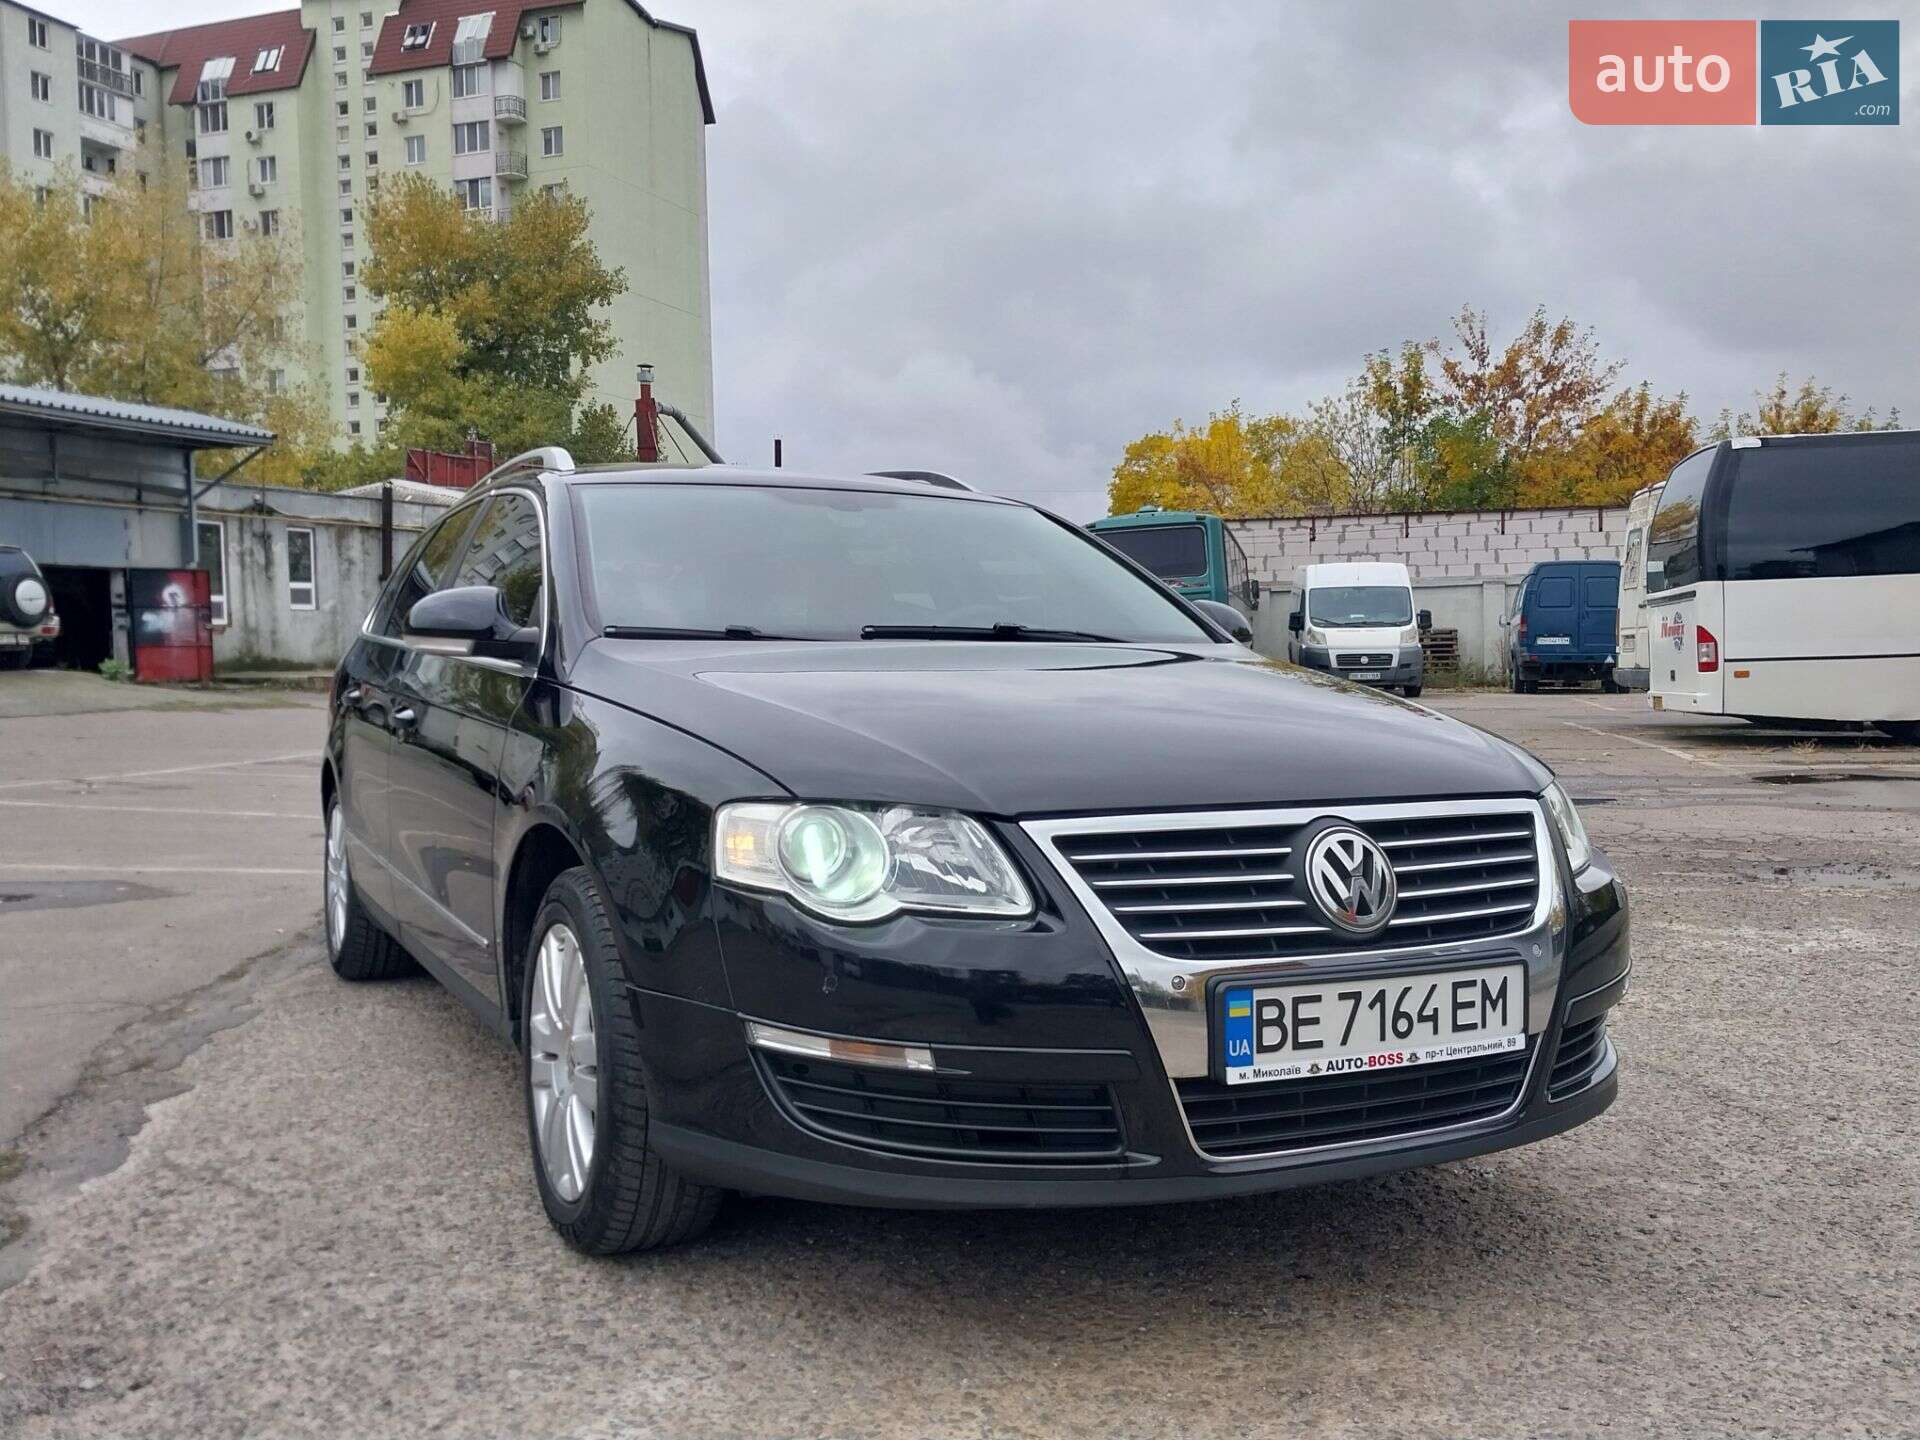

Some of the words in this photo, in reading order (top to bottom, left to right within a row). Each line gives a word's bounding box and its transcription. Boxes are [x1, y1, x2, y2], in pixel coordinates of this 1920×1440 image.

[1256, 994, 1324, 1054] BE
[1337, 983, 1440, 1047] 7164
[1451, 975, 1508, 1034] EM
[1229, 1039, 1251, 1057] UA
[1425, 1050, 1445, 1061] пр-т
[1507, 1037, 1517, 1048] 89
[1252, 1065, 1302, 1079] Миколаїв
[1325, 1052, 1404, 1073] AUTO-BOSS
